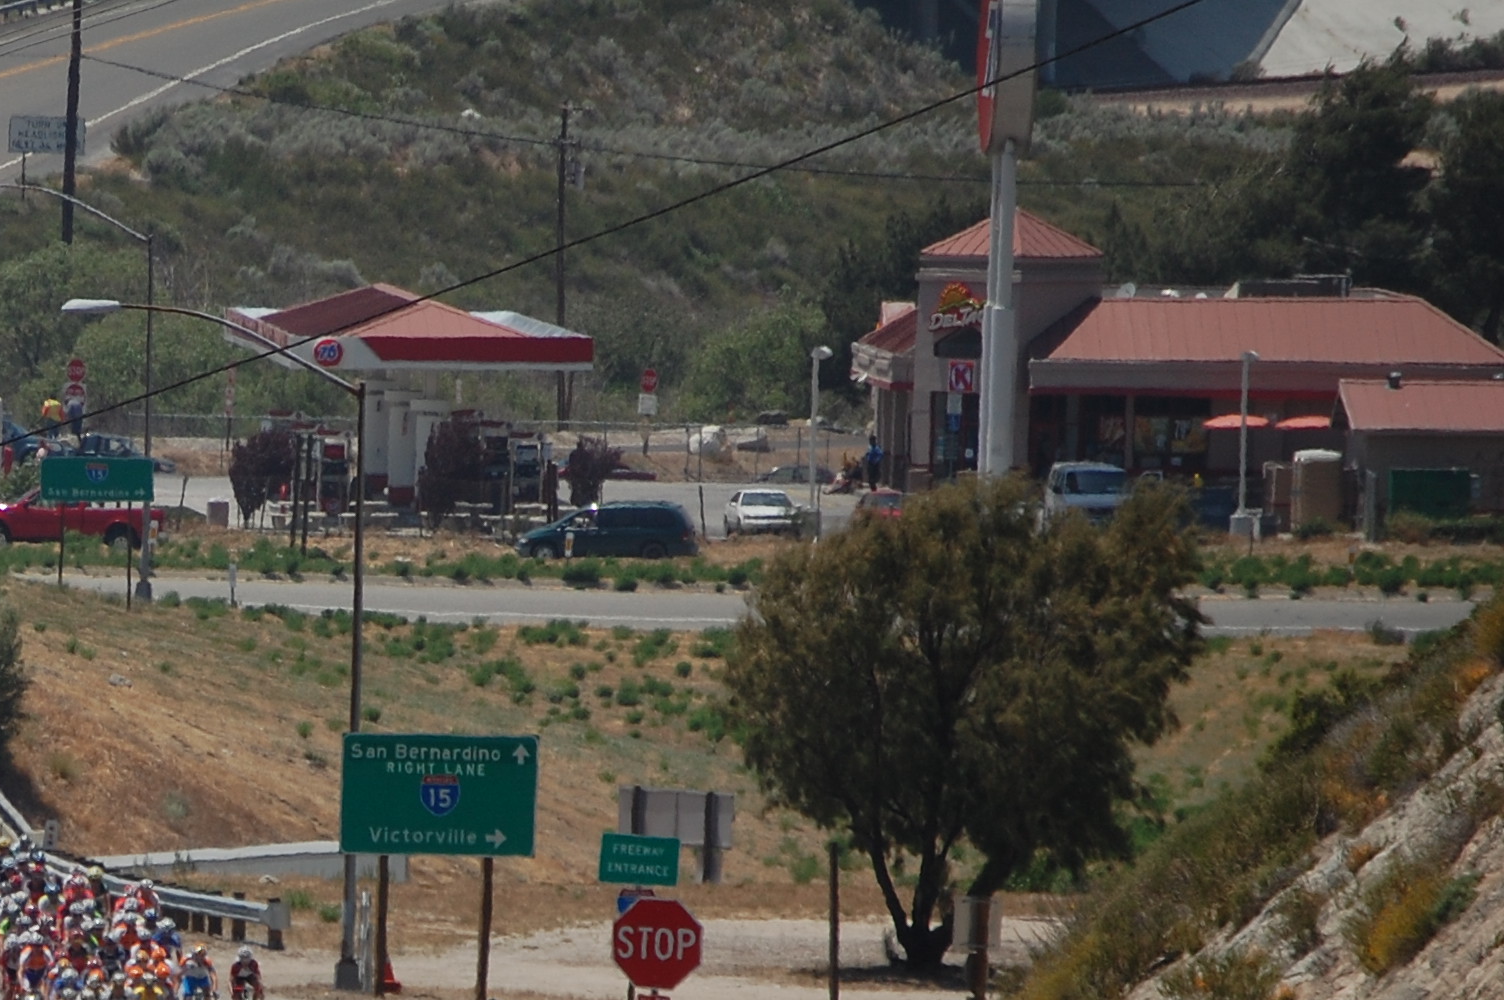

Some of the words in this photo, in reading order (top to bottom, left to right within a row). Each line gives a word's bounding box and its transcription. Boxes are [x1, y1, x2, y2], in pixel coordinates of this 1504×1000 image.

[319, 344, 337, 359] 76
[951, 363, 973, 391] K
[92, 470, 104, 481] 15
[351, 743, 387, 759] San
[395, 743, 501, 761] Bernardino
[386, 761, 434, 775] RIGHT
[446, 764, 485, 777] LANE
[428, 788, 452, 808] 15
[369, 827, 477, 845] Victorville
[612, 843, 665, 856] FREEWAY
[607, 861, 670, 877] ENTRANCE
[617, 926, 696, 961] STOP
